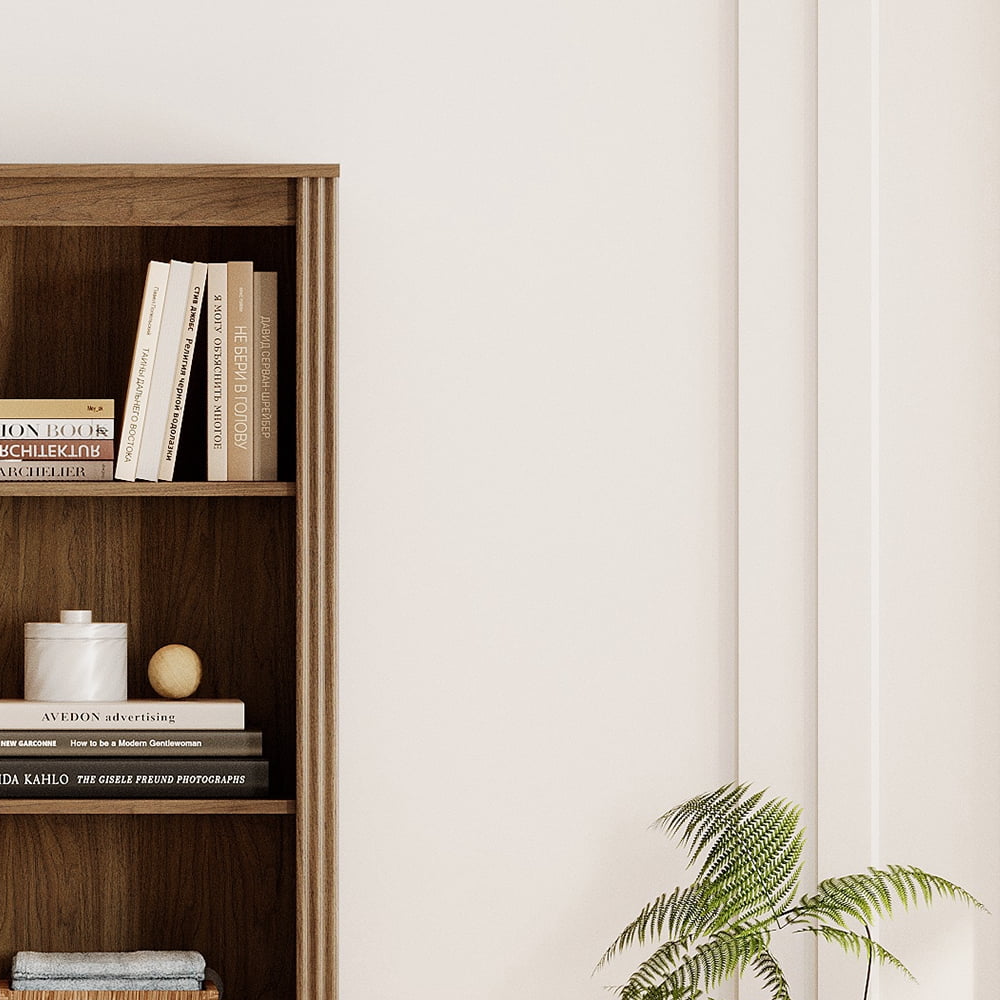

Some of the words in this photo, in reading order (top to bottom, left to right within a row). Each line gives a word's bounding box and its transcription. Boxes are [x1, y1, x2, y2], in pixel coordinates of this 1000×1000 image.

[213, 294, 222, 302] Я
[213, 304, 222, 334] МОГУ
[234, 325, 248, 343] НЕ
[260, 315, 271, 349] ДАВИД
[180, 338, 194, 376] Религия
[213, 337, 222, 402] ОБЪЯСНИТЬ
[234, 346, 248, 380] БЕРИ
[174, 377, 185, 411] черной
[234, 384, 248, 393] В
[261, 351, 272, 439] СЕРВАН-ШРЕЙБЕР
[166, 412, 180, 461] водолазки
[213, 405, 222, 450] МНОГОЕ
[234, 396, 248, 450] ГОЛОВУ
[124, 423, 137, 463] ВОСТОКА
[41, 712, 100, 722] AVEDON
[105, 712, 176, 724] advertising
[23, 773, 69, 785] KAHLO
[77, 775, 97, 784] THE
[98, 775, 133, 784] GISELE
[135, 775, 174, 784] FREUND
[176, 775, 245, 784] PHOTOGRAPHS
